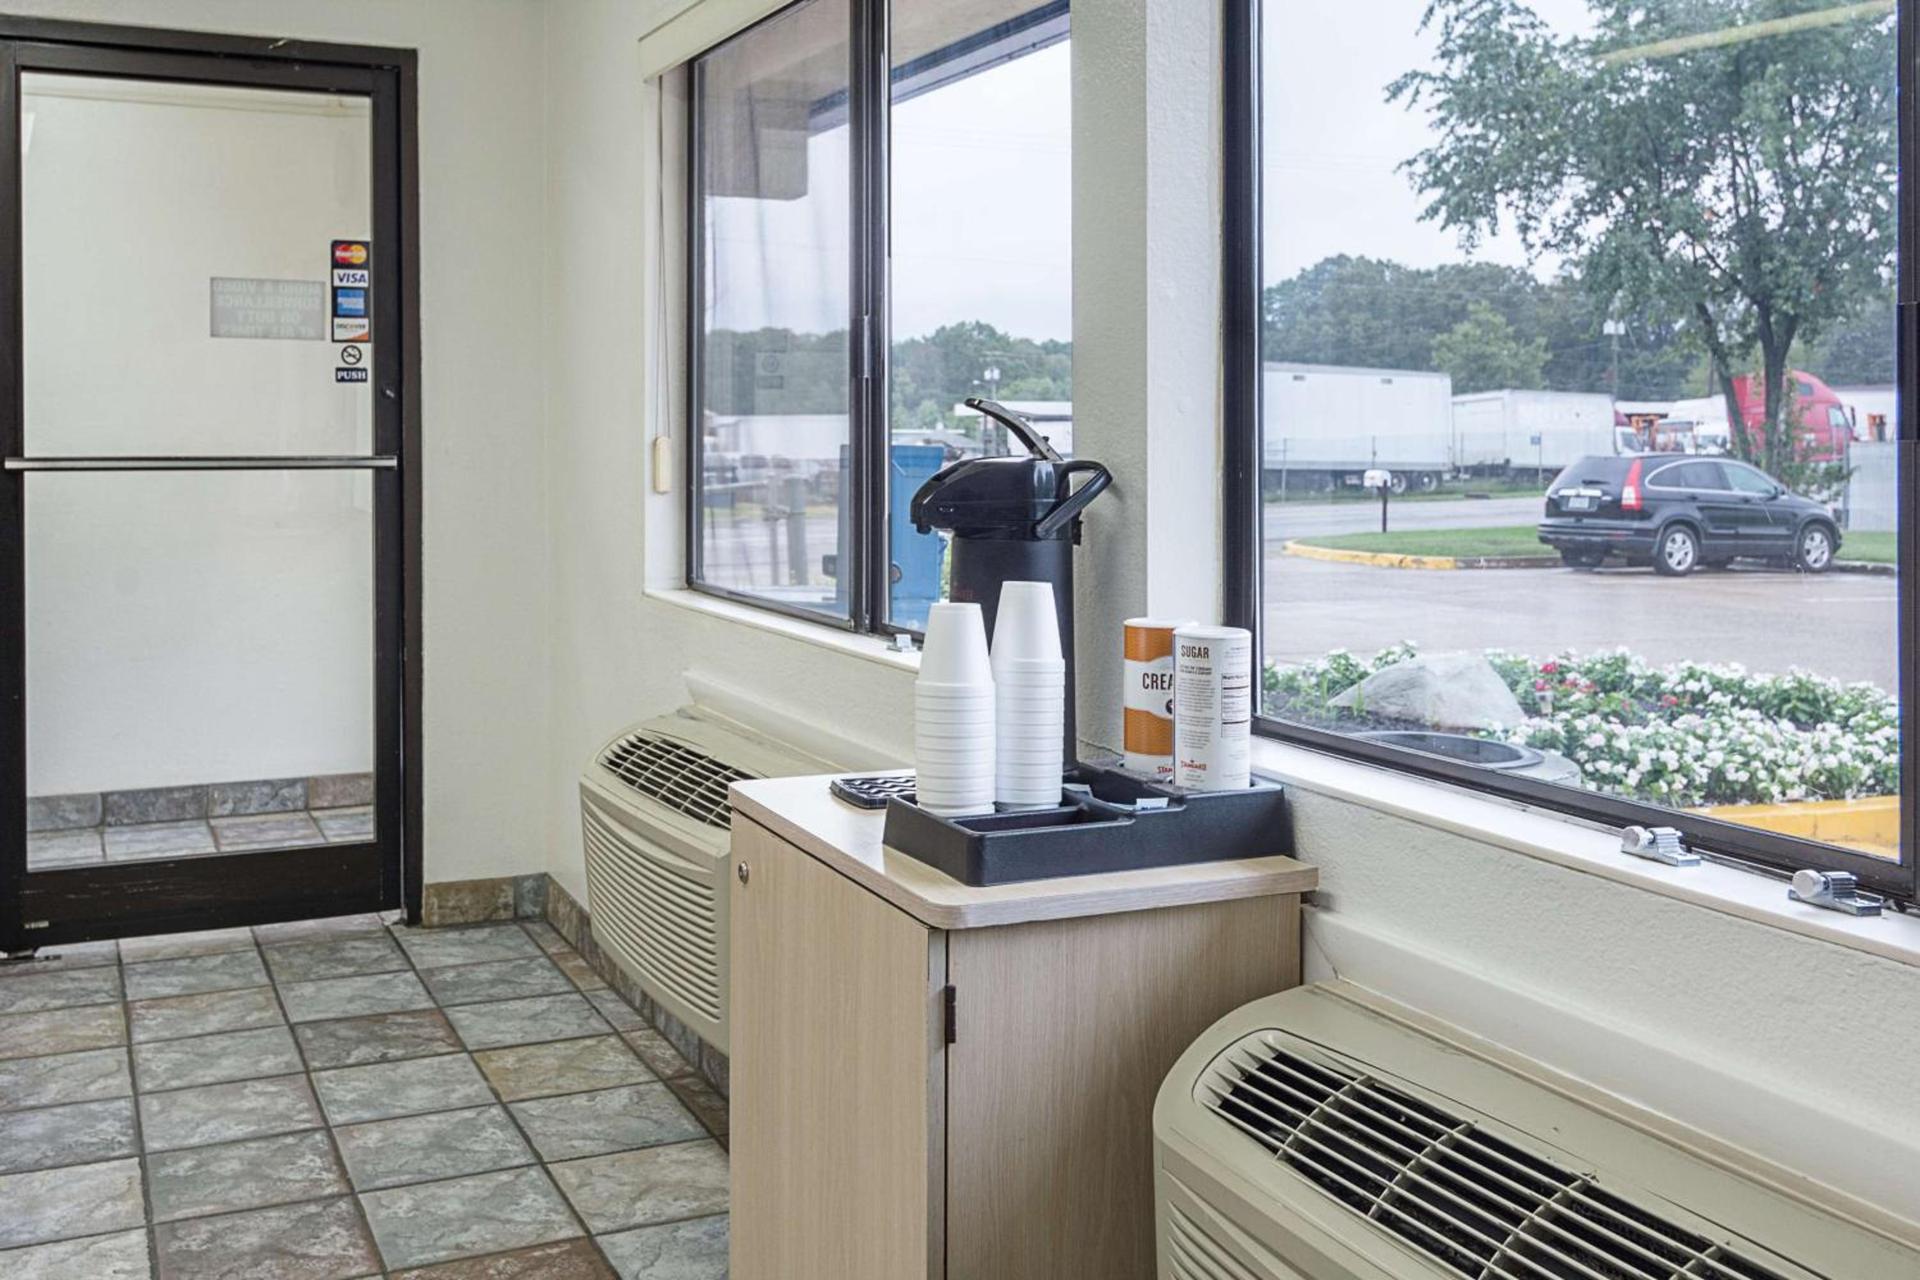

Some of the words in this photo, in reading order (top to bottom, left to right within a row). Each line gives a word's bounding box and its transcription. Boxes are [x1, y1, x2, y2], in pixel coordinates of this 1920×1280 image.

[336, 271, 367, 283] VISA
[337, 370, 366, 380] PUSH
[1181, 645, 1210, 659] SUGAR
